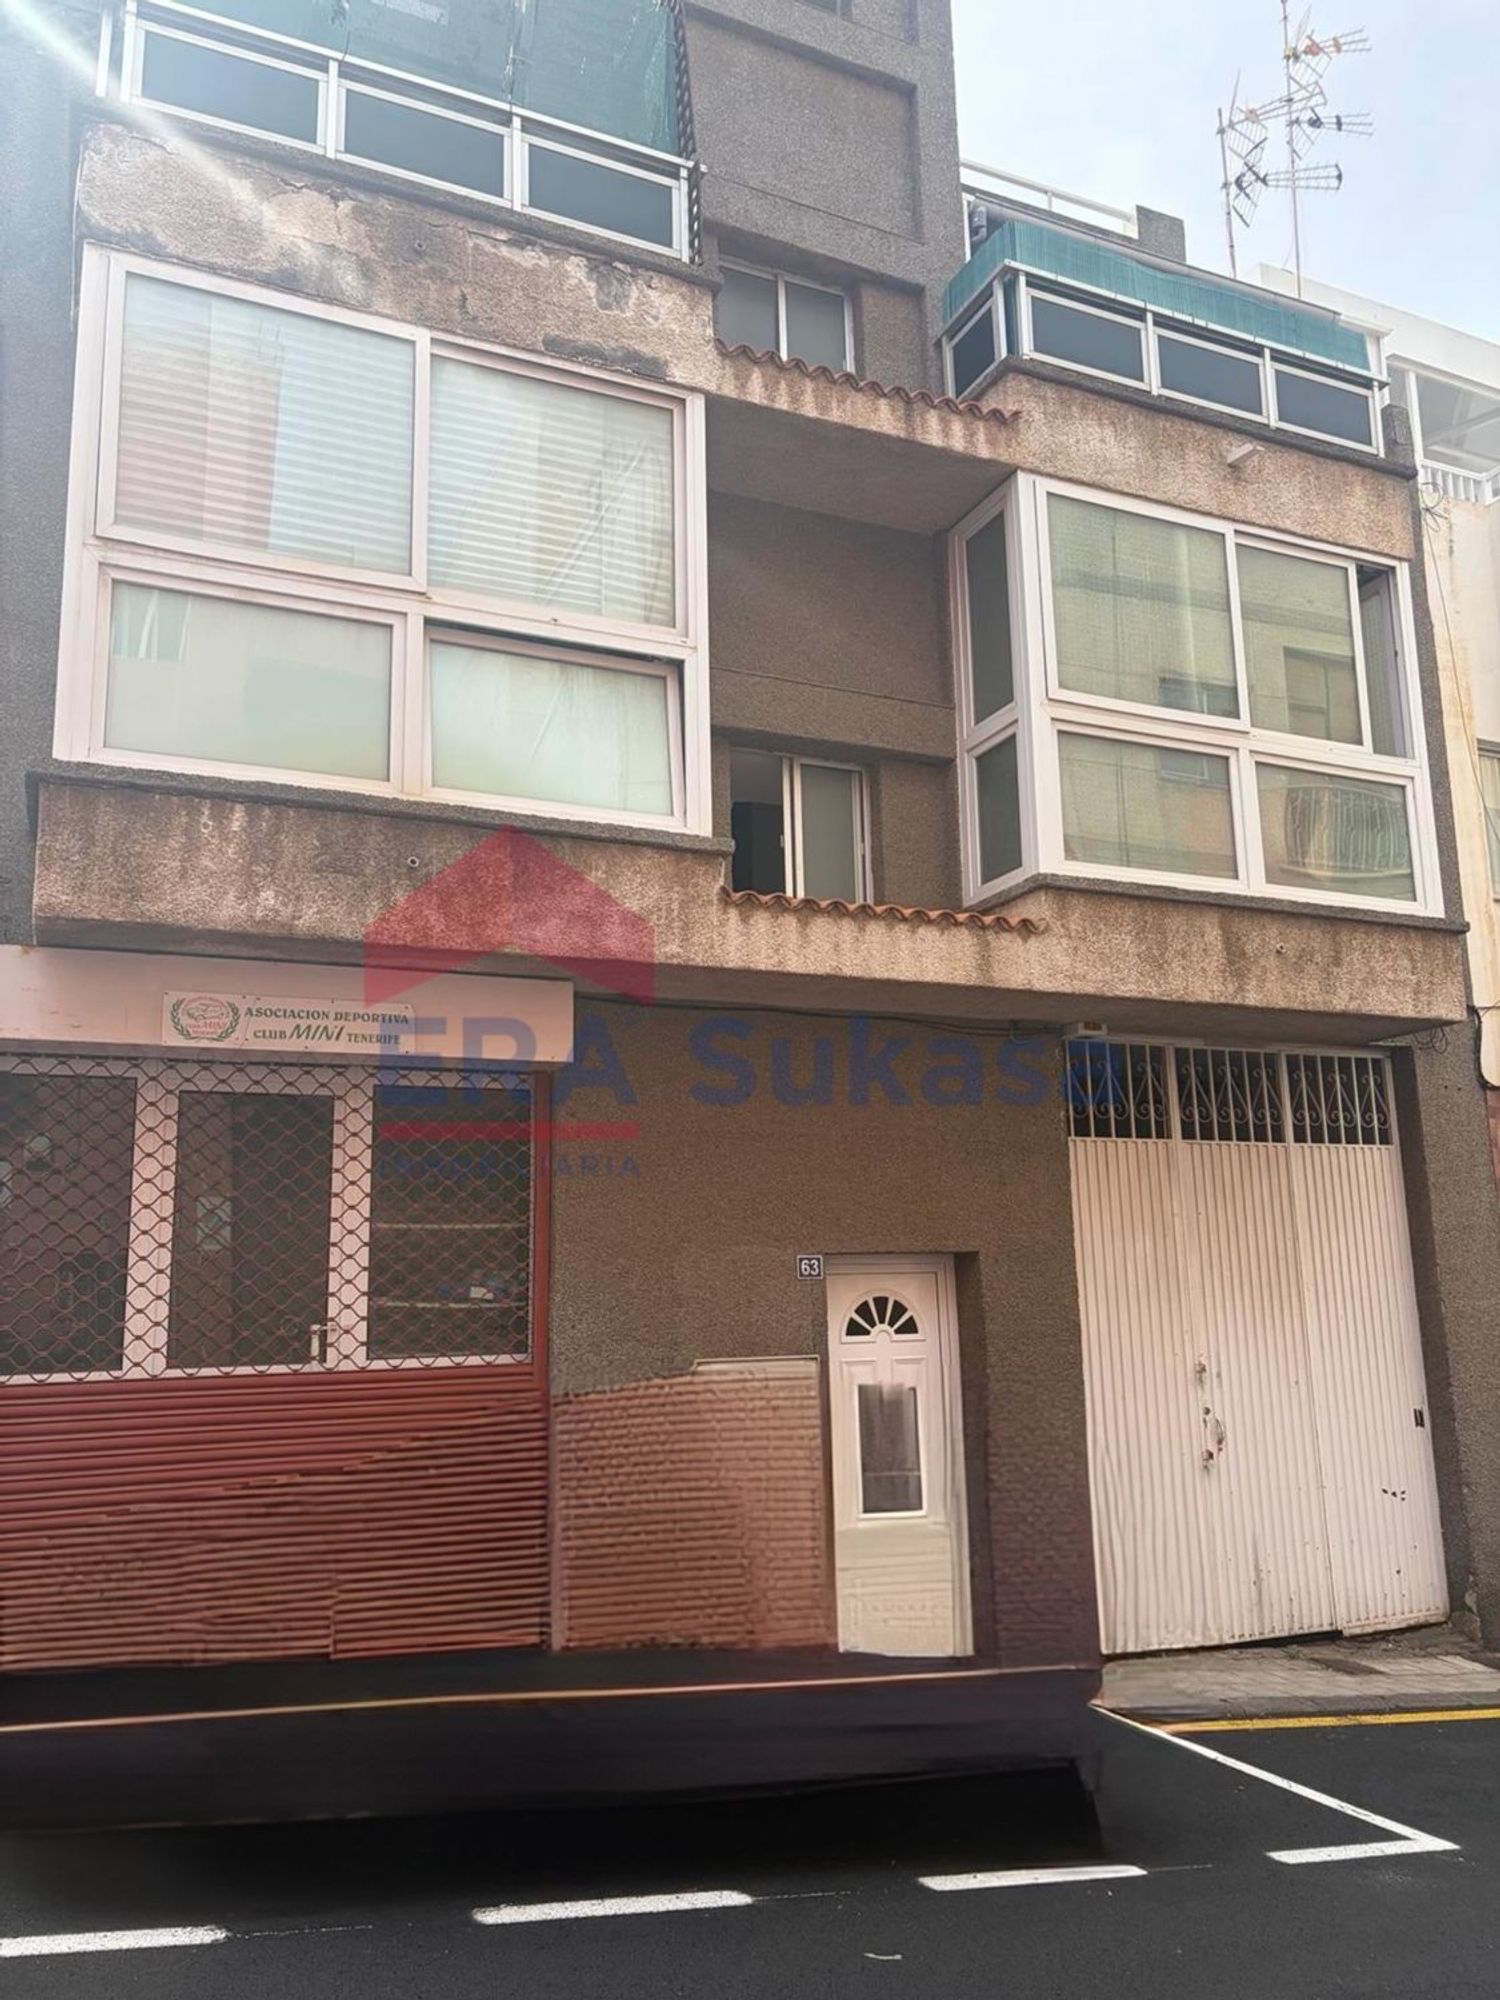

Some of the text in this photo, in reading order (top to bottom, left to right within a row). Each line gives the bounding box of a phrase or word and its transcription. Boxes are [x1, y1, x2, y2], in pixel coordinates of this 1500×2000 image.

[244, 1006, 409, 1026] ASOCIACION DEPORTIVA
[253, 1023, 400, 1045] CLUB MINI TENERIFE
[801, 1259, 820, 1276] 63
